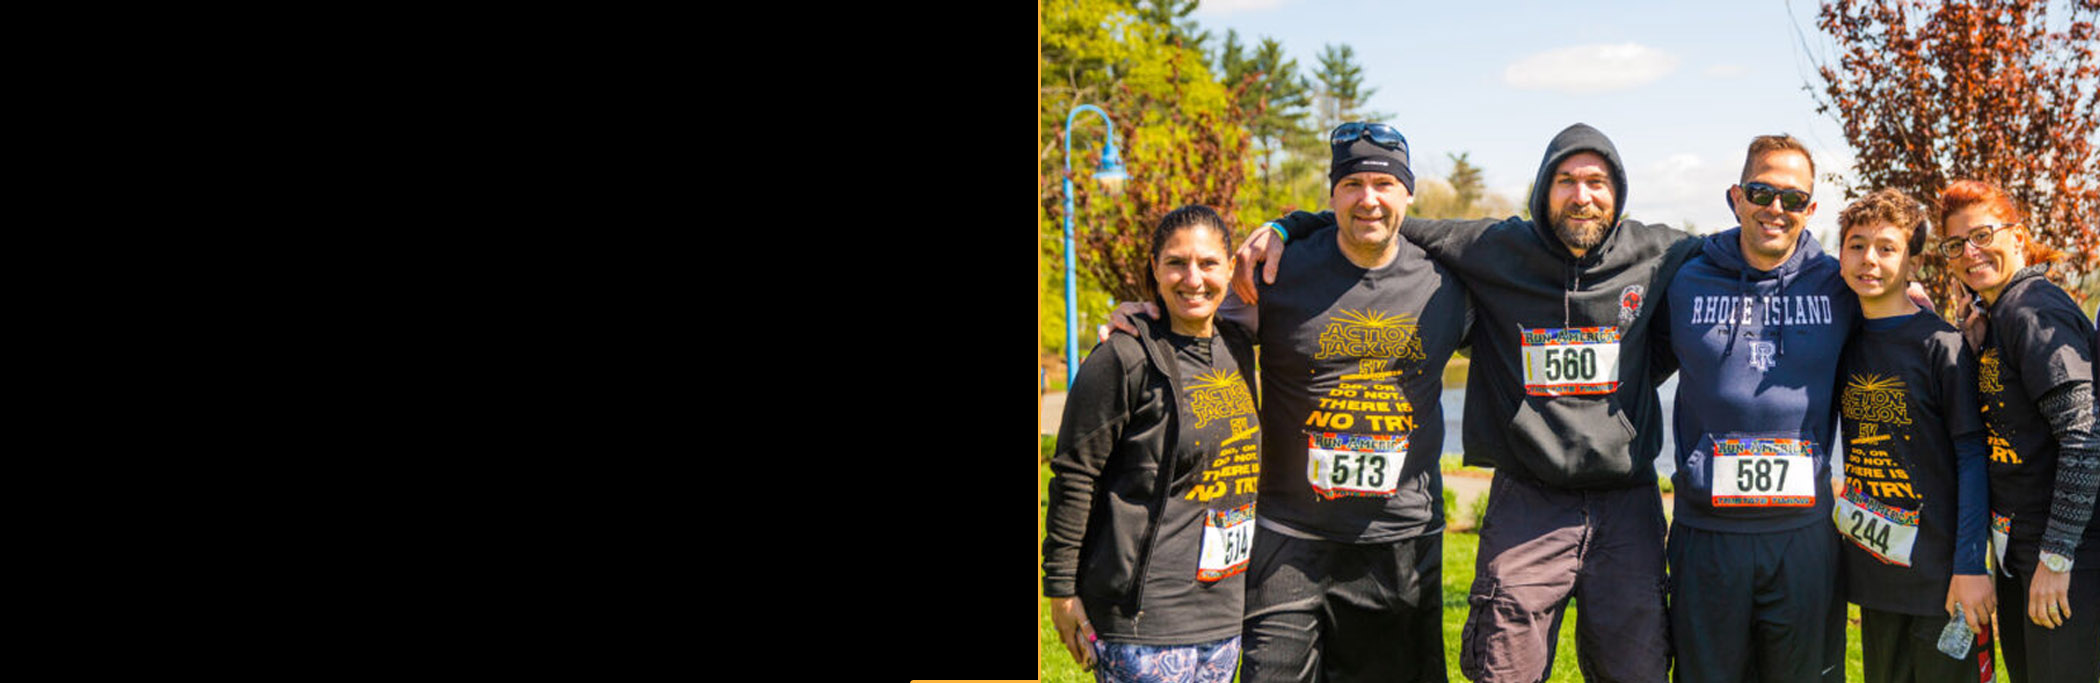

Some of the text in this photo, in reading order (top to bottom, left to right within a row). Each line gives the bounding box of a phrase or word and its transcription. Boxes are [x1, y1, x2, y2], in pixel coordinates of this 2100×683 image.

[1764, 295, 1833, 325] ISLAND
[1320, 323, 1422, 344] ACTION
[1526, 331, 1616, 343] RUN AMERICA
[1314, 339, 1427, 360] JACKSON
[1545, 348, 1597, 381] 560
[1329, 388, 1405, 400] DO NOT.
[1319, 398, 1414, 412] THERE IS
[1305, 410, 1419, 432] NO TRY.
[1331, 454, 1386, 488] 513
[1845, 463, 1910, 480] THERE IS
[1863, 457, 1899, 467] NOT.
[1202, 464, 1250, 482] THERE
[1737, 459, 1790, 493] 587
[1184, 480, 1227, 502] NO
[1867, 480, 1923, 500] TRY.
[1850, 510, 1892, 555] 244
[1224, 526, 1248, 565] 514
